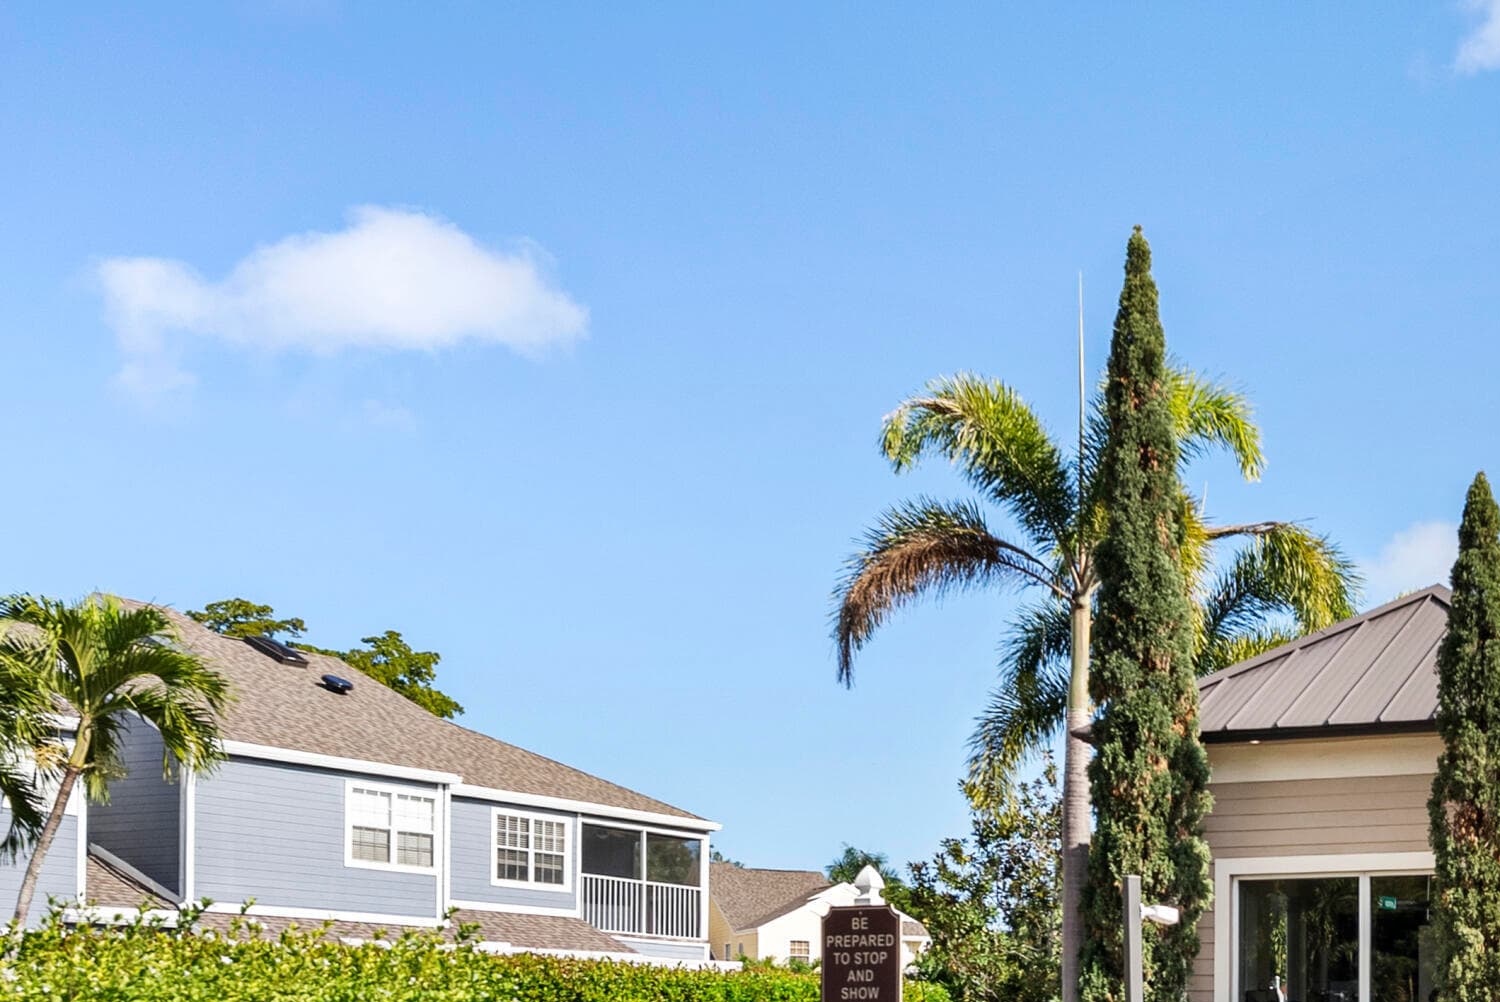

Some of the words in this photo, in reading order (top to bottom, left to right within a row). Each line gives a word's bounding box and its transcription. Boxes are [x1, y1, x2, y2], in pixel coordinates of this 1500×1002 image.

[851, 917, 869, 930] BE
[826, 934, 895, 948] PREPARED
[833, 952, 850, 965] TO
[853, 952, 888, 965] STOP
[847, 969, 875, 983] AND
[841, 987, 880, 1000] SHOW
